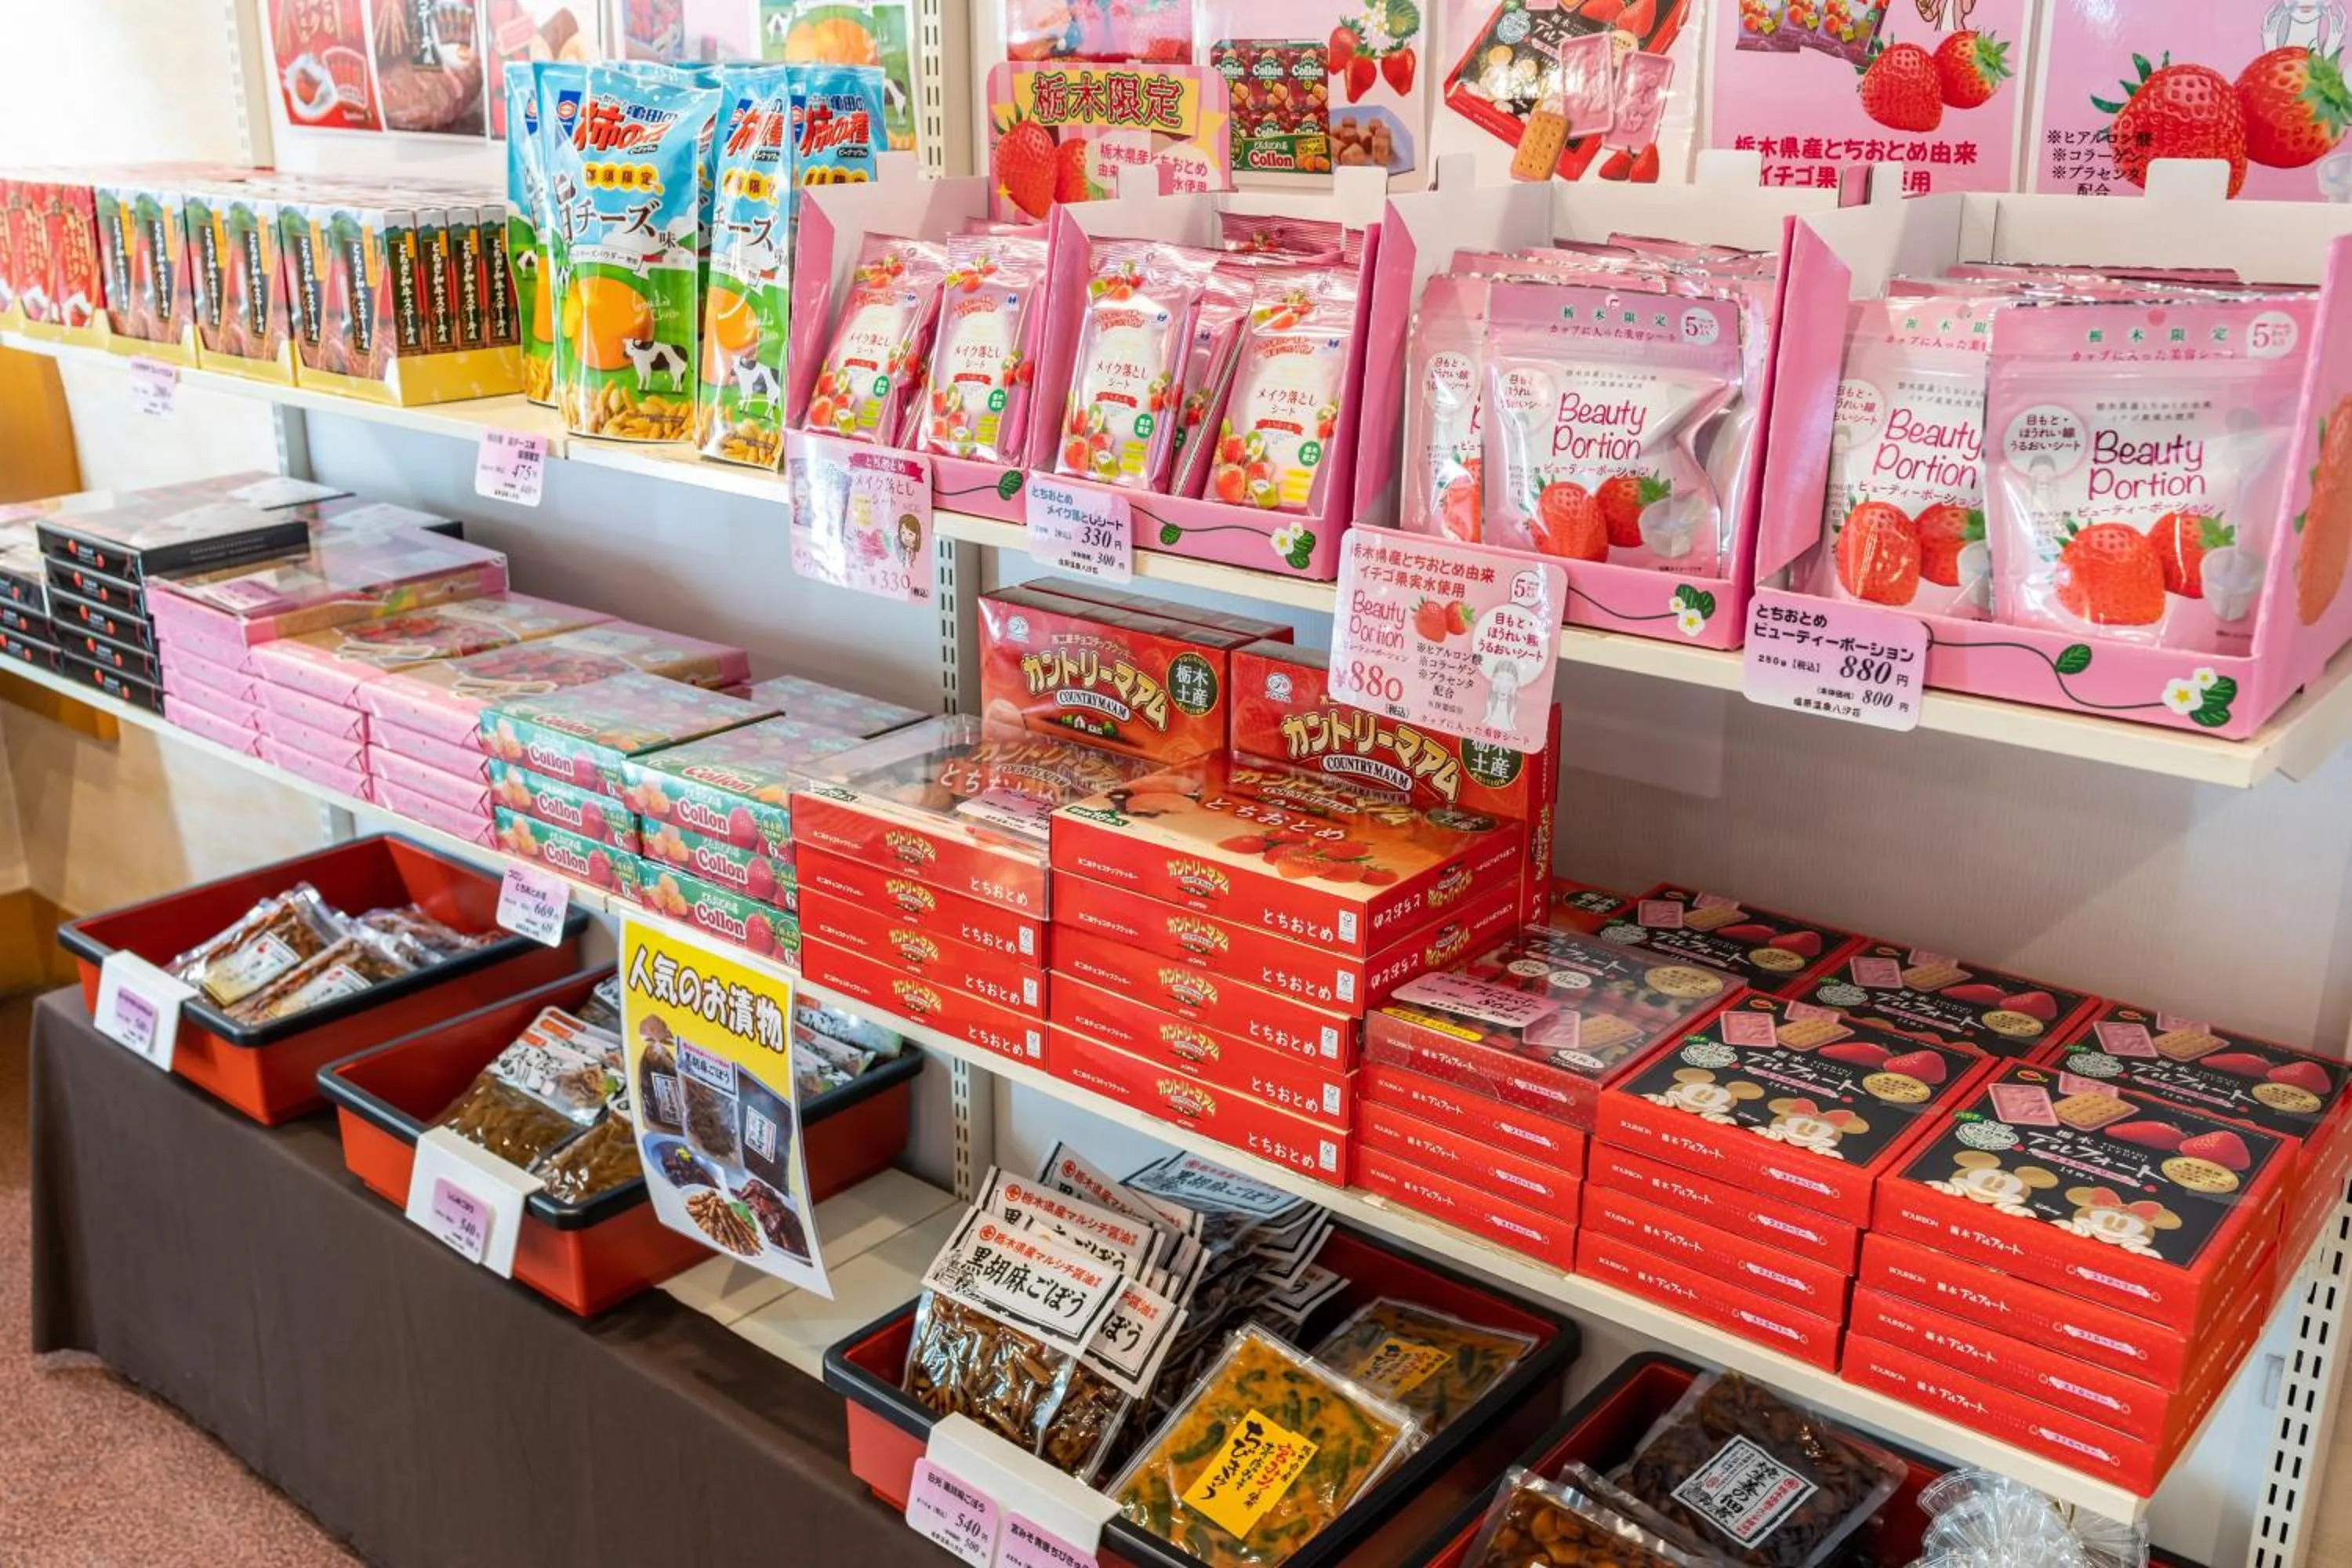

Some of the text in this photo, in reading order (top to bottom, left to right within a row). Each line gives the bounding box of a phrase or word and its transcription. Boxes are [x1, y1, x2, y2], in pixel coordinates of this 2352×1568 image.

[1253, 65, 1283, 76] Collon
[1292, 65, 1324, 76] Collon
[1033, 71, 1182, 128] 栃木限定
[1249, 151, 1293, 168] Collon
[1734, 135, 1977, 165] 栃木県産とちおとめ由来
[1686, 315, 1698, 336] 5
[2252, 323, 2270, 348] 5
[1559, 392, 1647, 436] Beauty
[1552, 426, 1642, 460] Portion
[1885, 408, 1981, 462] Beauty
[2009, 439, 2082, 452] うるおいシート
[2092, 430, 2204, 470] Beauty
[1872, 441, 1976, 488] Portion
[1032, 486, 1073, 505] とちおとめ
[2088, 466, 2206, 501] Portion
[1082, 527, 1112, 548] 330
[1359, 565, 1465, 598] イチゴ果実水使用
[1514, 580, 1526, 597] 5
[1352, 590, 1406, 630] Beauty
[1756, 604, 1828, 628] とちおとめ
[1349, 615, 1404, 649] Portion
[1754, 622, 1915, 662] ビューティーポーション
[1479, 641, 1544, 662] うるおいシート
[1176, 664, 1209, 684] 栃木
[1839, 655, 1893, 684] 880
[1896, 674, 1908, 687] 円
[1022, 648, 1168, 731] カントリーマアム
[1059, 691, 1098, 707] COUNTRY
[1177, 685, 1207, 708] 土産
[1433, 686, 1454, 699] 配合
[1861, 689, 1894, 707] 800
[528, 745, 573, 773] Collon
[1282, 709, 1461, 804] カントリーマアム
[1327, 757, 1410, 788] COUNTRY MA'AM
[1471, 755, 1511, 779] 土産
[538, 794, 581, 825] Collon
[678, 801, 728, 832] Collon
[1205, 798, 1345, 840] とちおとめ
[545, 841, 589, 873] Collon
[697, 850, 746, 883] Collon
[971, 877, 1029, 906] とちおとめ
[695, 905, 745, 937] Collon
[1263, 907, 1334, 942] とちおとめ
[962, 924, 1016, 954] とちおとめ
[628, 945, 784, 1053] 人気のお漬物
[965, 974, 1020, 1005] とちおとめ
[1262, 967, 1331, 1001] とちおとめ
[967, 1025, 1023, 1058] とちおとめ
[1249, 1020, 1316, 1056] とちおとめ
[1251, 1076, 1319, 1112] とちおとめ
[1248, 1132, 1316, 1169] とちおとめ
[2027, 1131, 2169, 1183] アルフォート
[960, 1244, 1087, 1318] 黒胡麻ごぼう
[954, 1512, 981, 1537] 540
